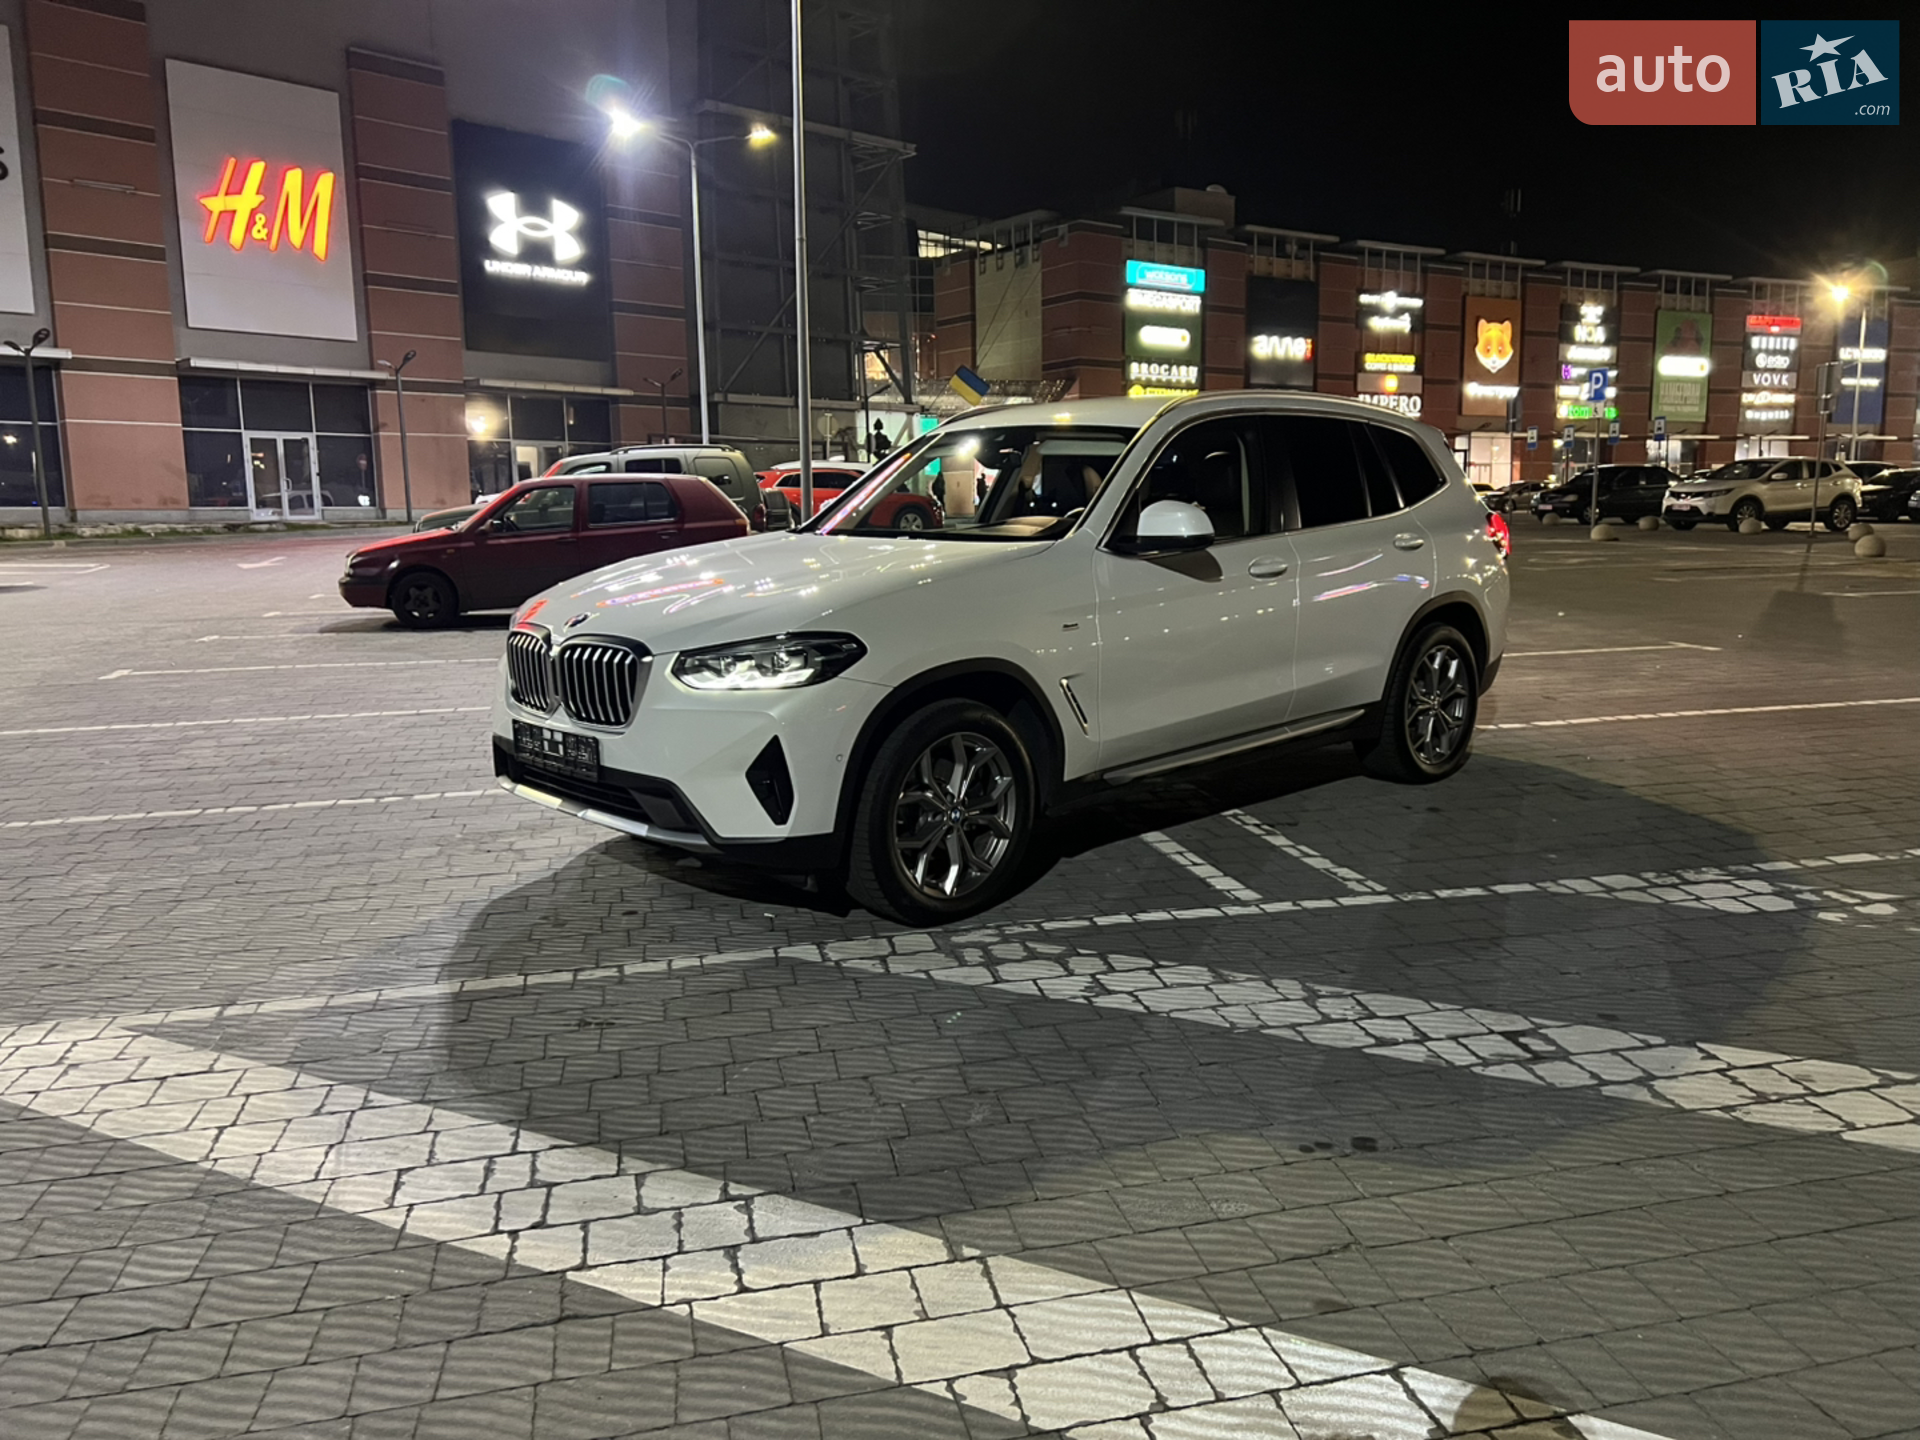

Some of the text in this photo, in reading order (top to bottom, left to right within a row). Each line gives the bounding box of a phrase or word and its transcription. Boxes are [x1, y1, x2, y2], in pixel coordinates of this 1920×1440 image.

[199, 156, 336, 262] H&M
[484, 259, 590, 285] UNDER ARMOUR
[1129, 361, 1199, 382] BROCARD
[1753, 373, 1789, 386] VOVK
[1590, 372, 1604, 398] P
